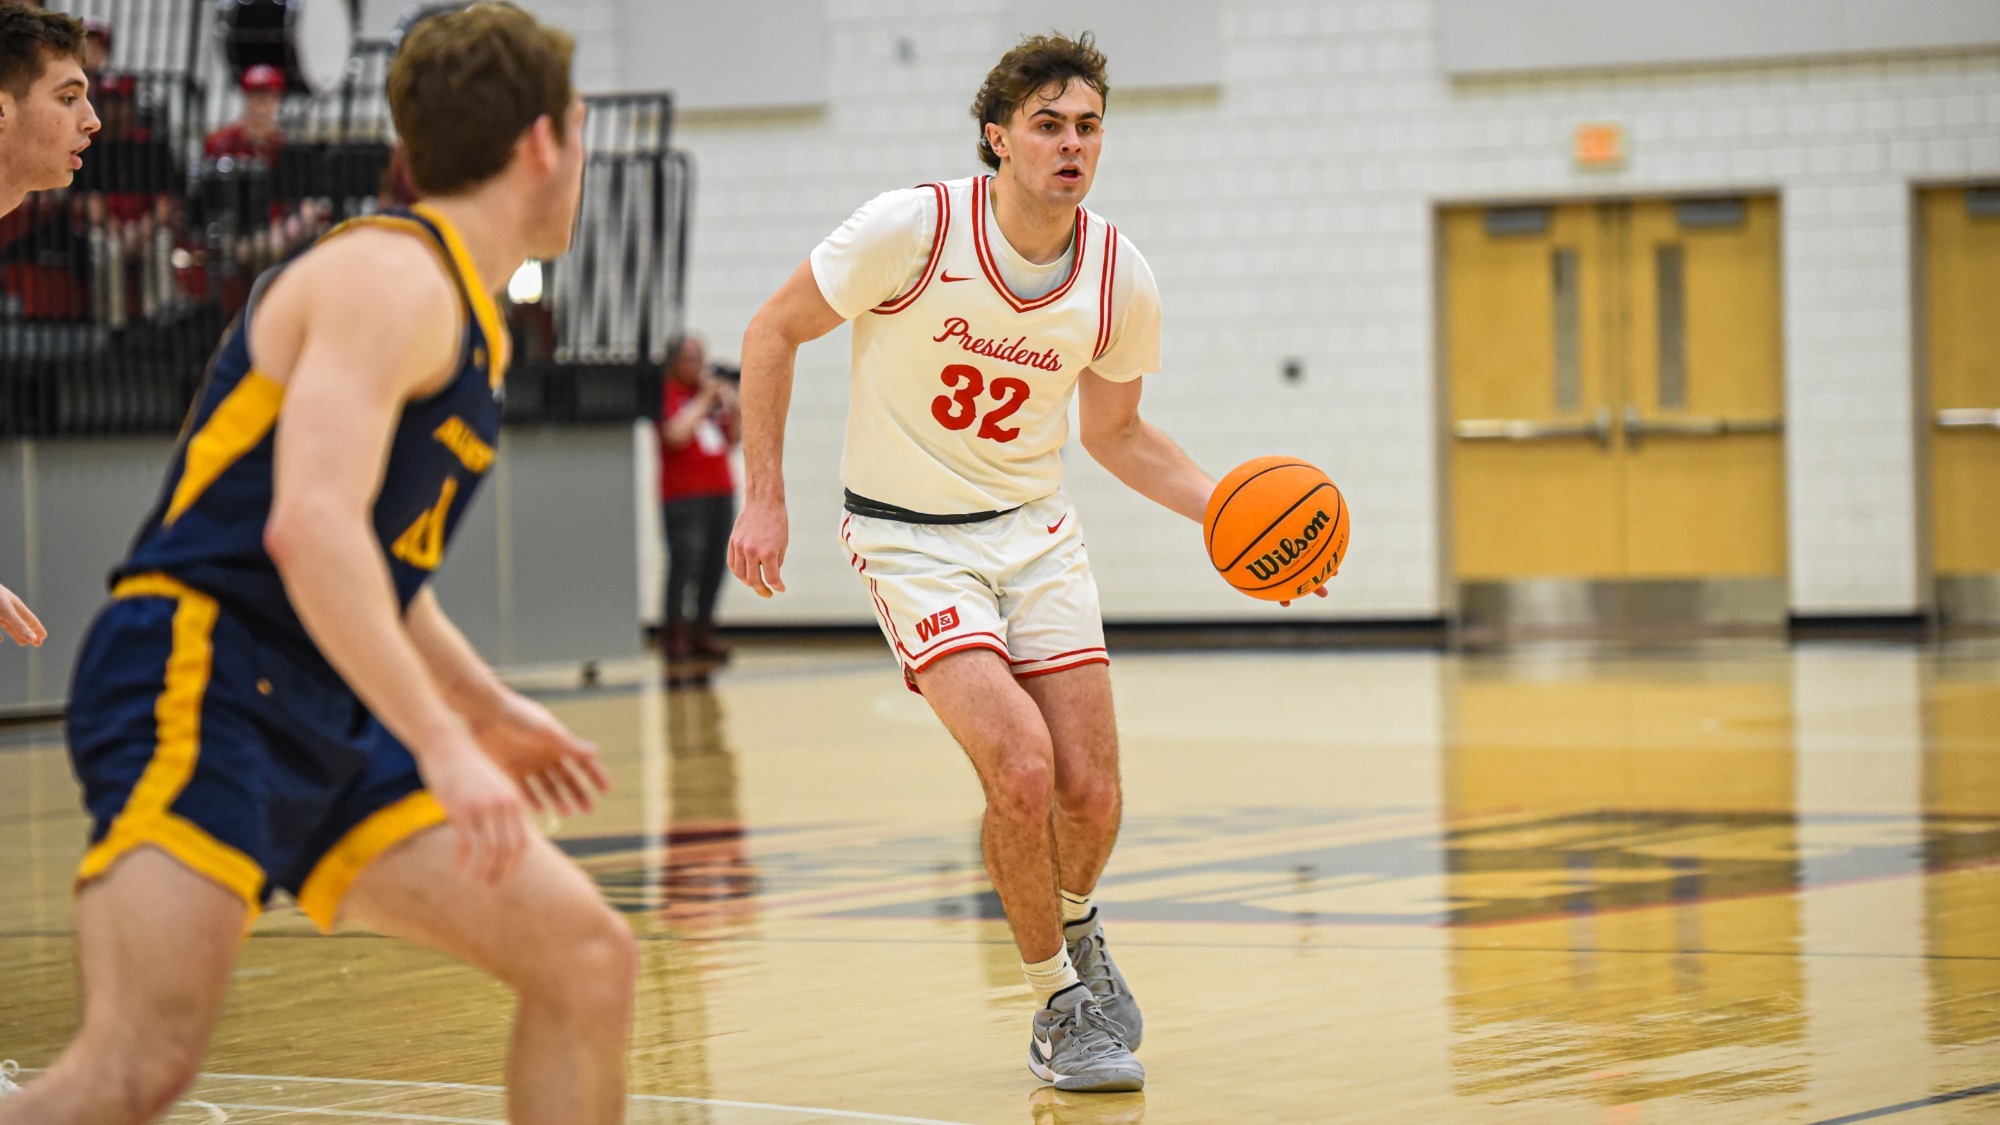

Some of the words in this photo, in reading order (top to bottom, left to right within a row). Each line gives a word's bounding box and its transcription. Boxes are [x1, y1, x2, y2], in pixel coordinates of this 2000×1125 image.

[933, 317, 1062, 371] Presidents
[931, 364, 1030, 443] 32
[1246, 509, 1330, 581] Wilson
[1297, 551, 1339, 596] EVO
[915, 605, 960, 644] W&J
